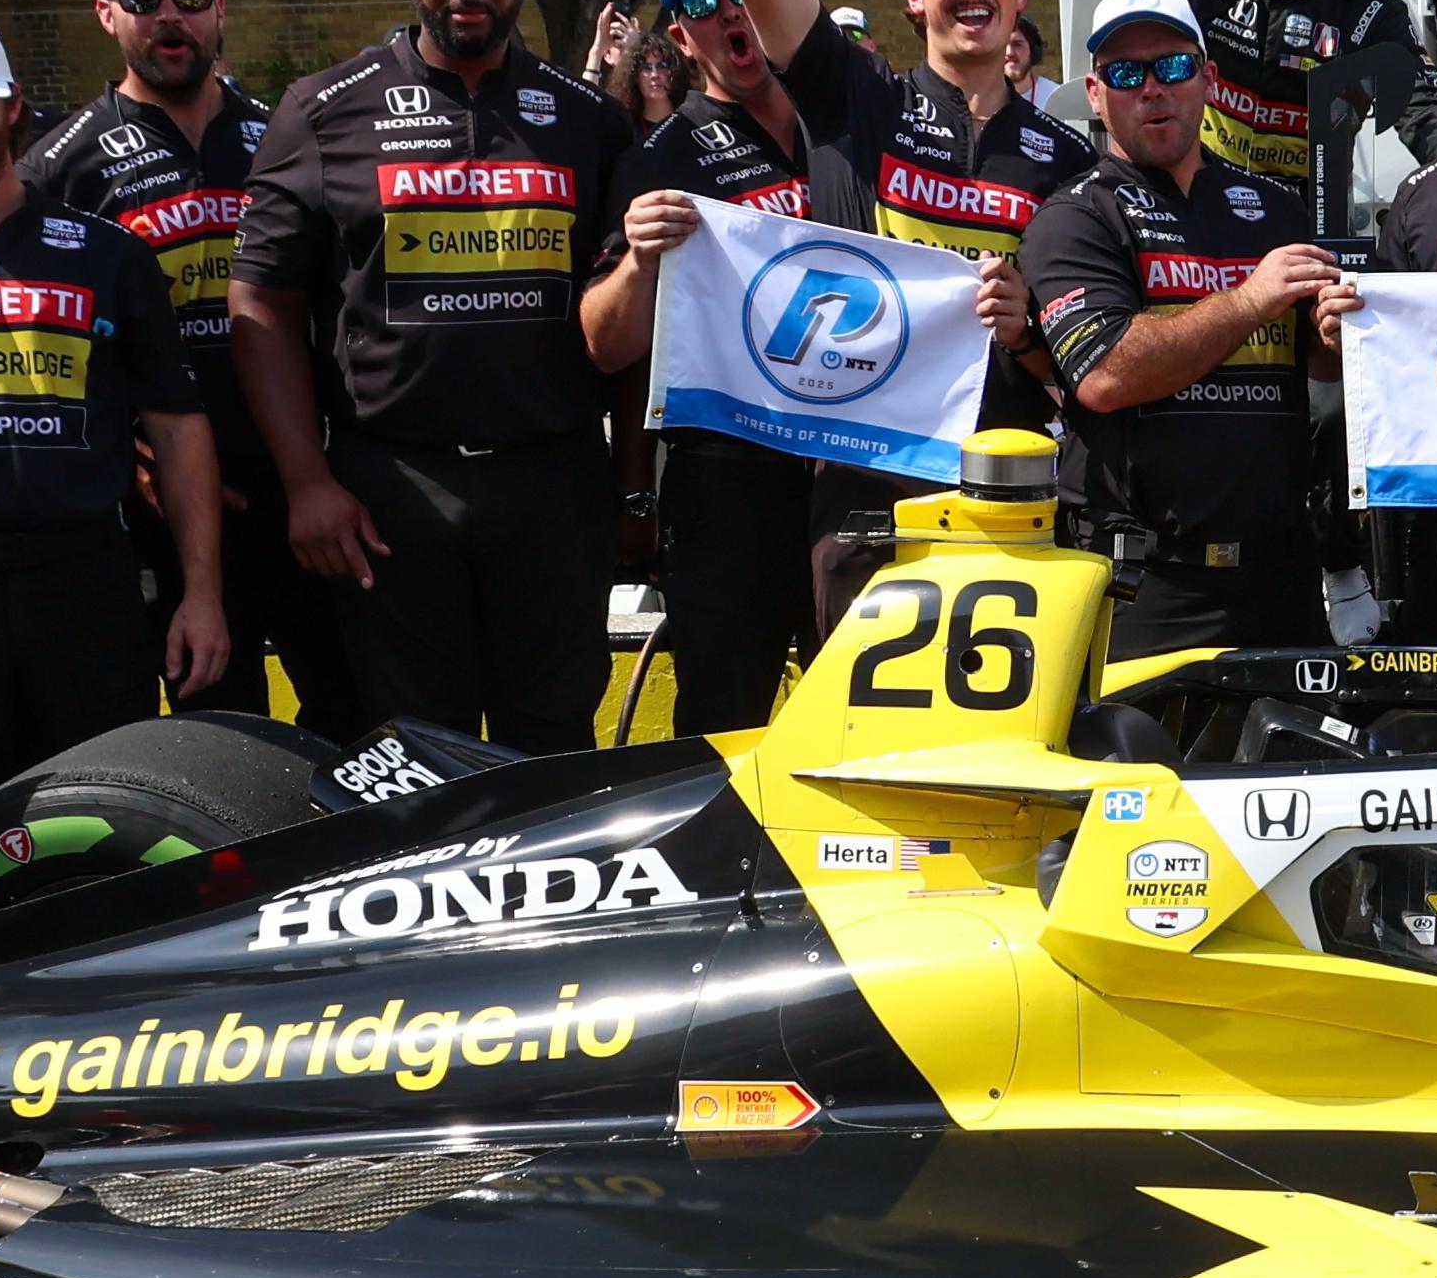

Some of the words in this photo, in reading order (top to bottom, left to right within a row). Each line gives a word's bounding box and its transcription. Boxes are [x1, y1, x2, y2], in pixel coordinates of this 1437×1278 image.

[317, 62, 381, 102] Firestone
[1206, 81, 1309, 130] ANDRETT
[374, 115, 452, 131] HONDA
[381, 138, 452, 151] GROUP1001
[697, 142, 762, 167] HONDA
[1216, 128, 1307, 166] GAINBRIDG
[101, 148, 174, 180] HONDA
[716, 163, 773, 186] GROUP1001
[1316, 144, 1325, 188] TORONTO
[115, 170, 181, 199] GROUP1001
[393, 168, 568, 198] ANDRETTI
[887, 166, 1039, 221] ANDRETT
[1316, 190, 1325, 202] OF
[1316, 203, 1325, 235] STREETS
[428, 228, 566, 254] GAINBRIDGE
[1341, 254, 1367, 266] NTT
[423, 290, 542, 313] GROUP1001
[844, 357, 877, 373] NTT
[798, 376, 835, 391] 2025
[1174, 382, 1282, 404] GROUP1001
[734, 412, 793, 439] STREETS
[798, 427, 817, 442] OF
[822, 430, 889, 456] TORONTO
[847, 579, 1039, 711] 26
[333, 736, 410, 793] GROUP
[1105, 791, 1144, 819] PPG
[468, 833, 521, 861] by
[823, 841, 889, 866] Herta
[1164, 857, 1202, 873] NTT
[248, 846, 699, 951] HONDA
[1125, 882, 1209, 898] INDYCAR
[1140, 896, 1191, 906] SERIES
[12, 983, 637, 1119] gainbridge.io
[736, 1090, 777, 1103] 100%
